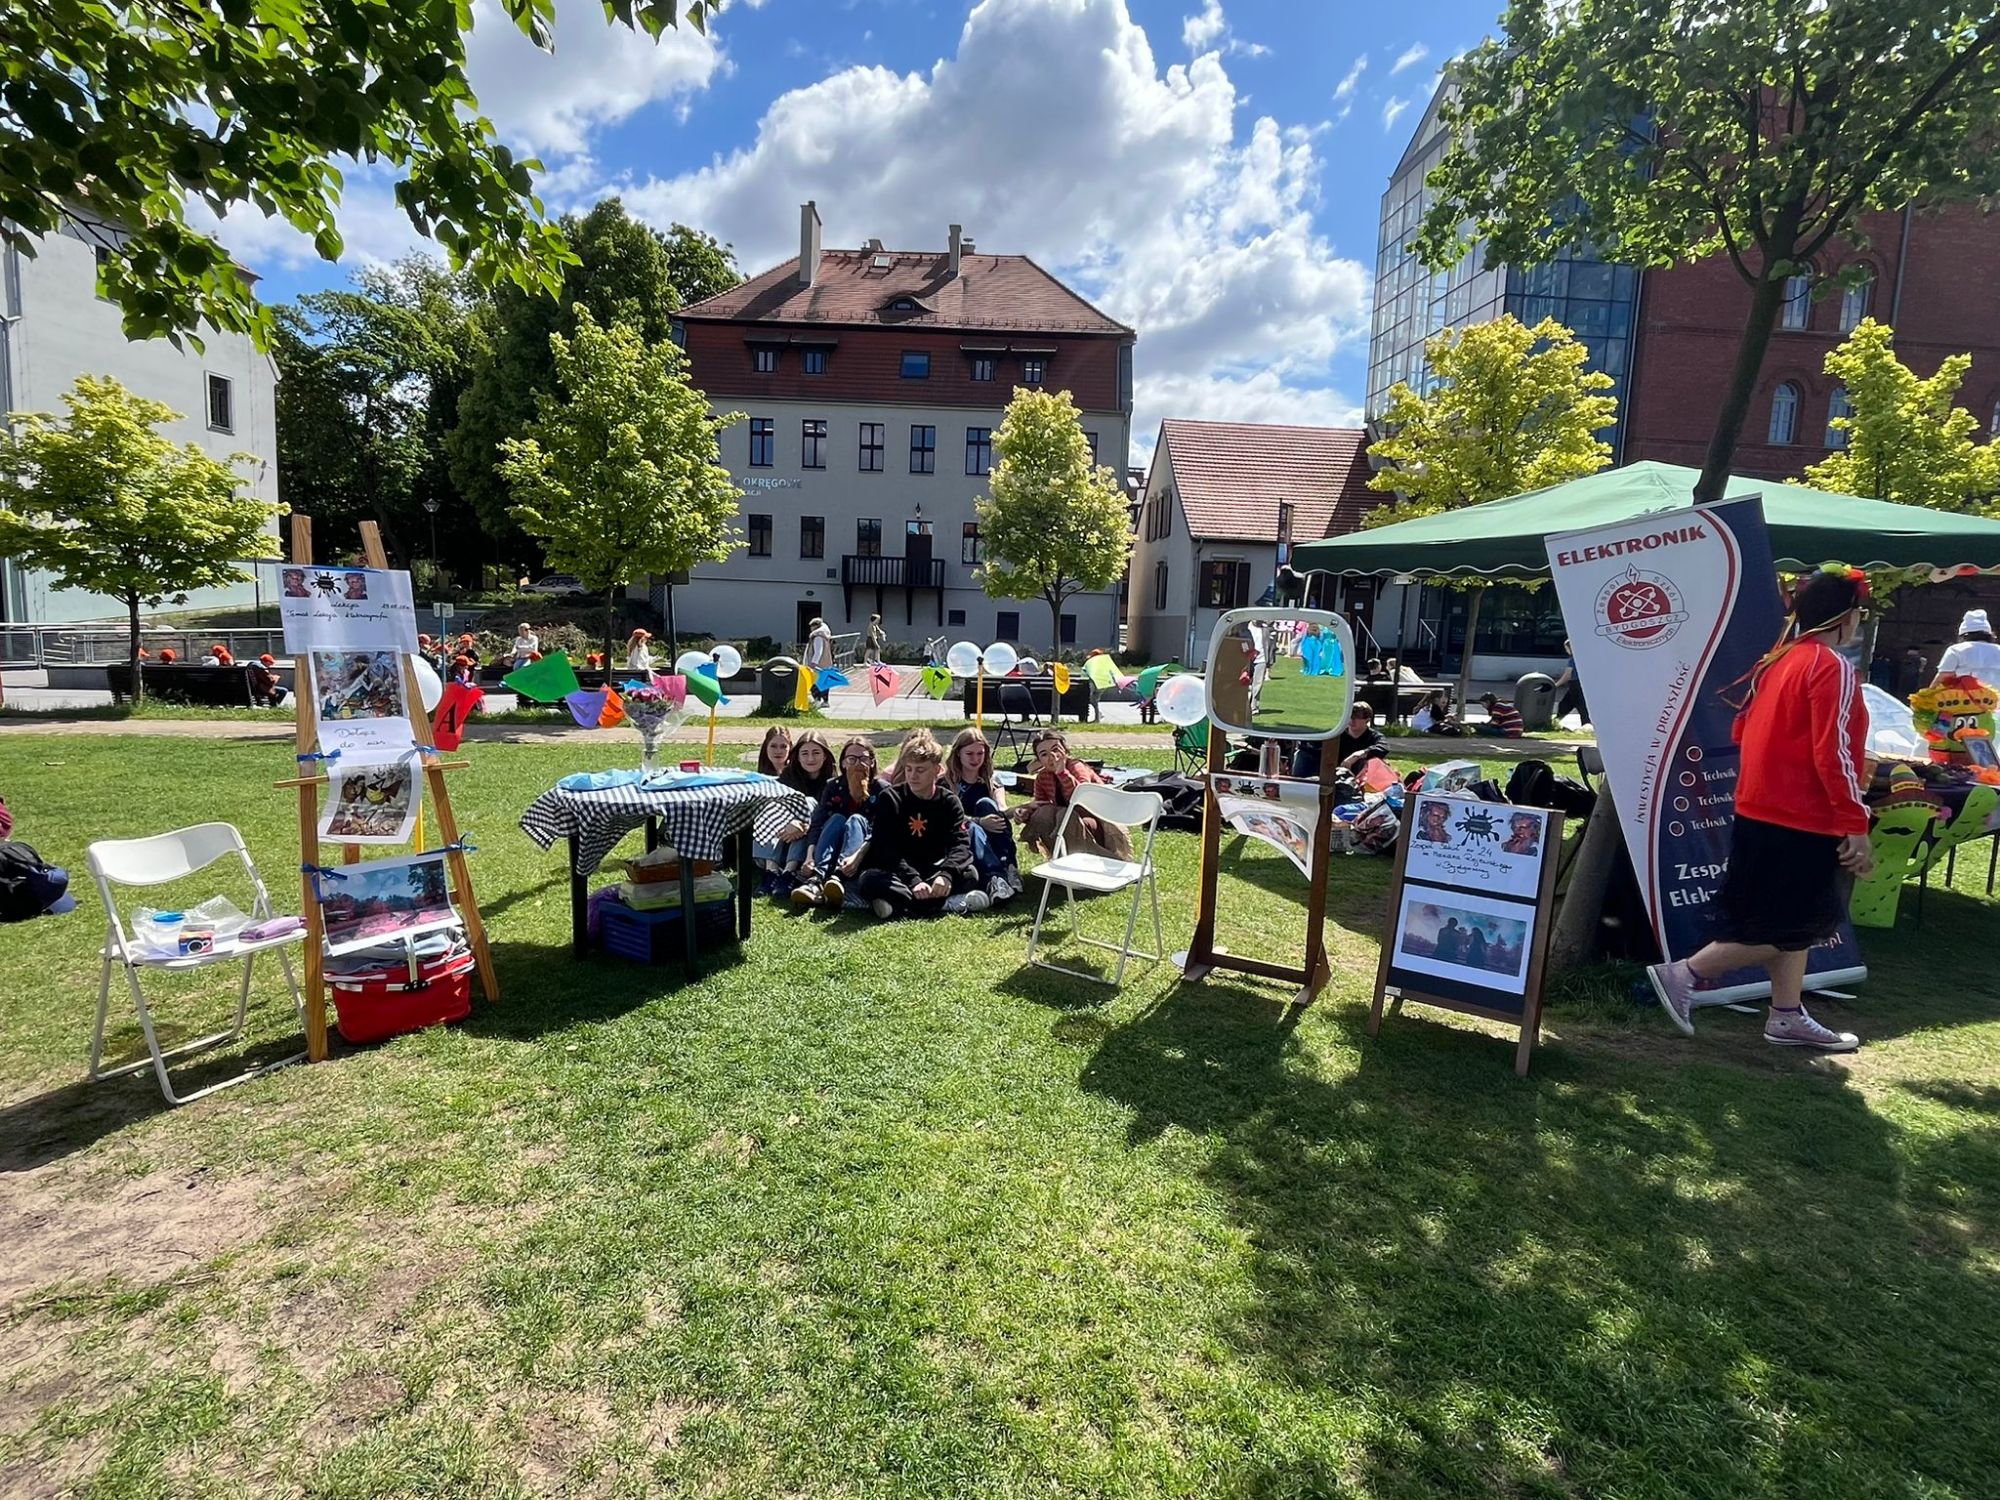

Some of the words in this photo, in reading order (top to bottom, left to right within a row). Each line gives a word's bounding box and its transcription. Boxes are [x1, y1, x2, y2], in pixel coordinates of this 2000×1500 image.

[1557, 525, 1707, 566] ELEKTRONIK
[1605, 614, 1680, 633] BYDGOSZCZ
[436, 703, 457, 734] A
[1478, 847, 1492, 857] 24
